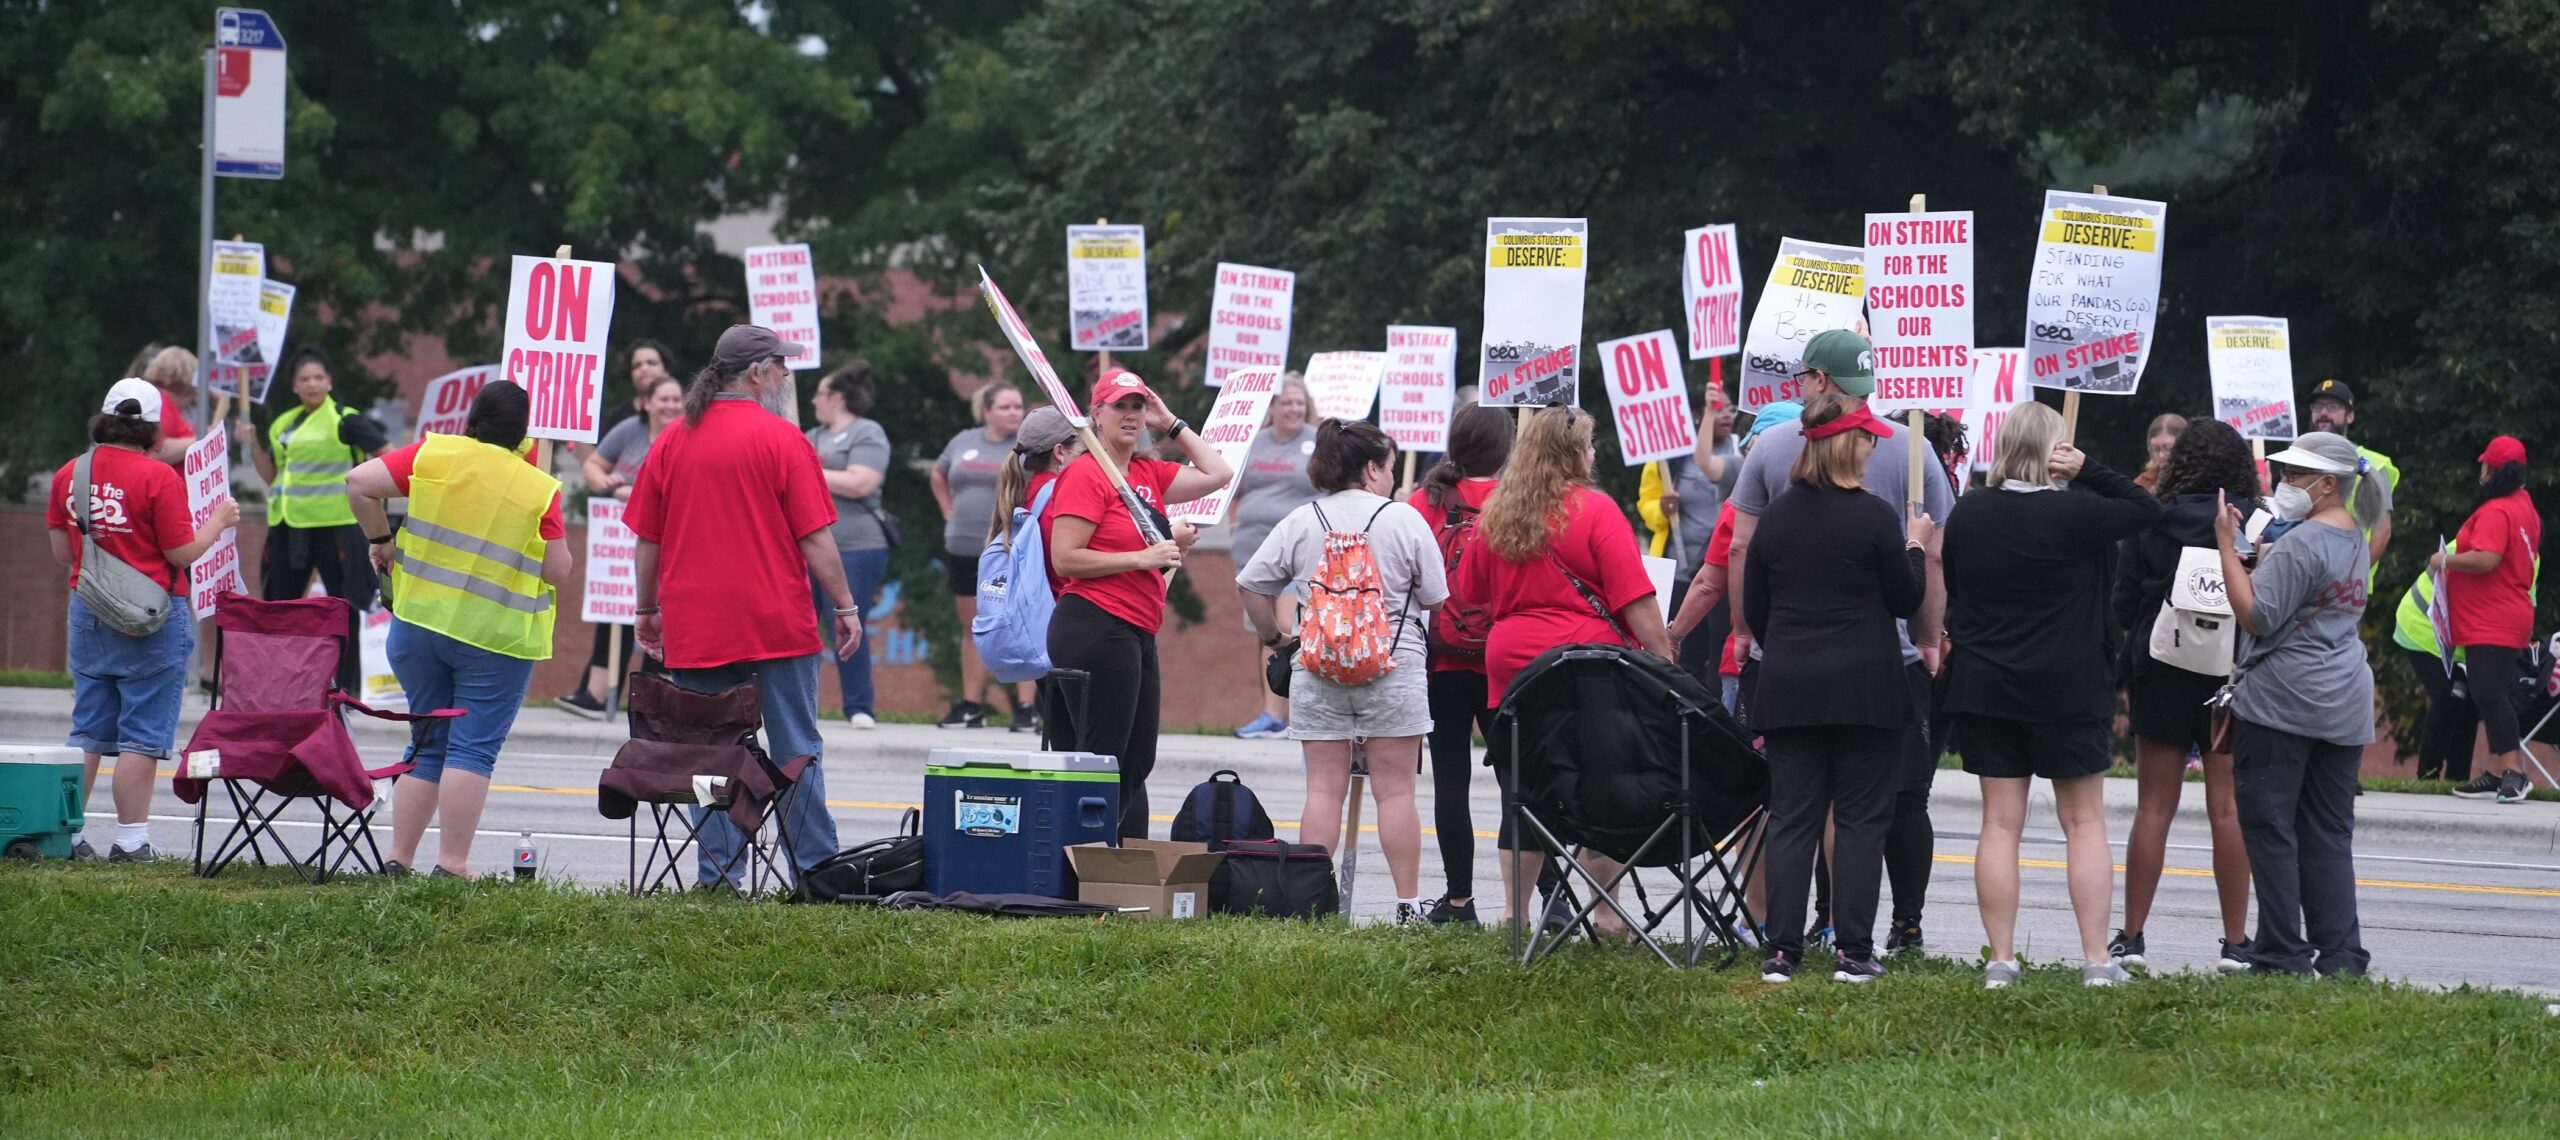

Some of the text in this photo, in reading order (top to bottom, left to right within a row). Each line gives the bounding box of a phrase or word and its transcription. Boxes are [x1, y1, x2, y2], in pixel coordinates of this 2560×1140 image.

[220, 52, 227, 75] 1
[2062, 210, 2144, 228] COLUMBUS STUDENTS
[1504, 235, 1572, 246] COLUMBUS STUDENTS
[1869, 220, 1967, 246] ON STRIKE
[2063, 223, 2136, 250] DESERVE:
[749, 250, 807, 269] ON STRIKE
[1507, 247, 1566, 267] DESERVE:
[1698, 231, 1732, 288] ON
[1793, 257, 1859, 275] COLUMBUS STUDENTS
[1884, 254, 1947, 275] FOR THE
[2046, 248, 2125, 269] STANDING
[760, 272, 798, 286] FOR THE
[1220, 271, 1289, 292] ON STRIKE
[1791, 268, 1854, 295] DESERVE:
[2038, 270, 2115, 289] FOR WHAT
[525, 262, 592, 342] ON
[753, 290, 811, 307] SCHOOLS
[1230, 293, 1273, 309] FOR THE
[1793, 292, 1827, 315] the
[1869, 284, 1965, 310] SCHOOLS
[2035, 292, 2062, 307] OUR
[2071, 293, 2122, 312] PANDAS
[772, 312, 793, 324] OUR
[1217, 310, 1283, 331] SCHOOLS
[1694, 291, 1738, 351] STRIKE
[1898, 317, 1931, 337] OUR
[2066, 310, 2140, 331] DESERVE!
[776, 328, 815, 342] DENTS
[1236, 332, 1259, 345] OUR
[1390, 332, 1450, 347] ON STRIKE
[2035, 324, 2074, 341] cea
[1212, 347, 1281, 366] STUDENTS
[1399, 353, 1434, 365] FOR THE
[1489, 346, 1520, 360] cea
[1873, 345, 1968, 368] STUDENTS
[2034, 332, 2140, 378] ON STRIKE
[1488, 345, 1574, 398] ON STRIKE
[1615, 337, 1668, 397] ON
[1751, 356, 1788, 374] cea
[1219, 377, 1233, 399] ON
[1233, 372, 1277, 395] STRIKE
[1386, 372, 1445, 387] SCHOOLS
[1985, 353, 2018, 402] N
[2322, 380, 2333, 391] P
[1402, 391, 1423, 404] OUR
[1748, 384, 1774, 405] ON
[1877, 376, 1963, 400] DESERVE!
[1232, 400, 1254, 416] THE
[1383, 409, 1445, 424] STUDENTS
[2245, 400, 2289, 424] STRIKE
[1203, 424, 1253, 445] SCHOOLS
[1618, 395, 1692, 458] STRIKE
[187, 430, 225, 475] ON STRIKE
[211, 466, 223, 487] THE
[103, 482, 124, 499] the
[592, 503, 609, 519] ON
[592, 543, 635, 560] SCHOO
[589, 580, 635, 597] STUDEN
[2198, 577, 2225, 593] MK
[590, 601, 636, 617] DESERV
